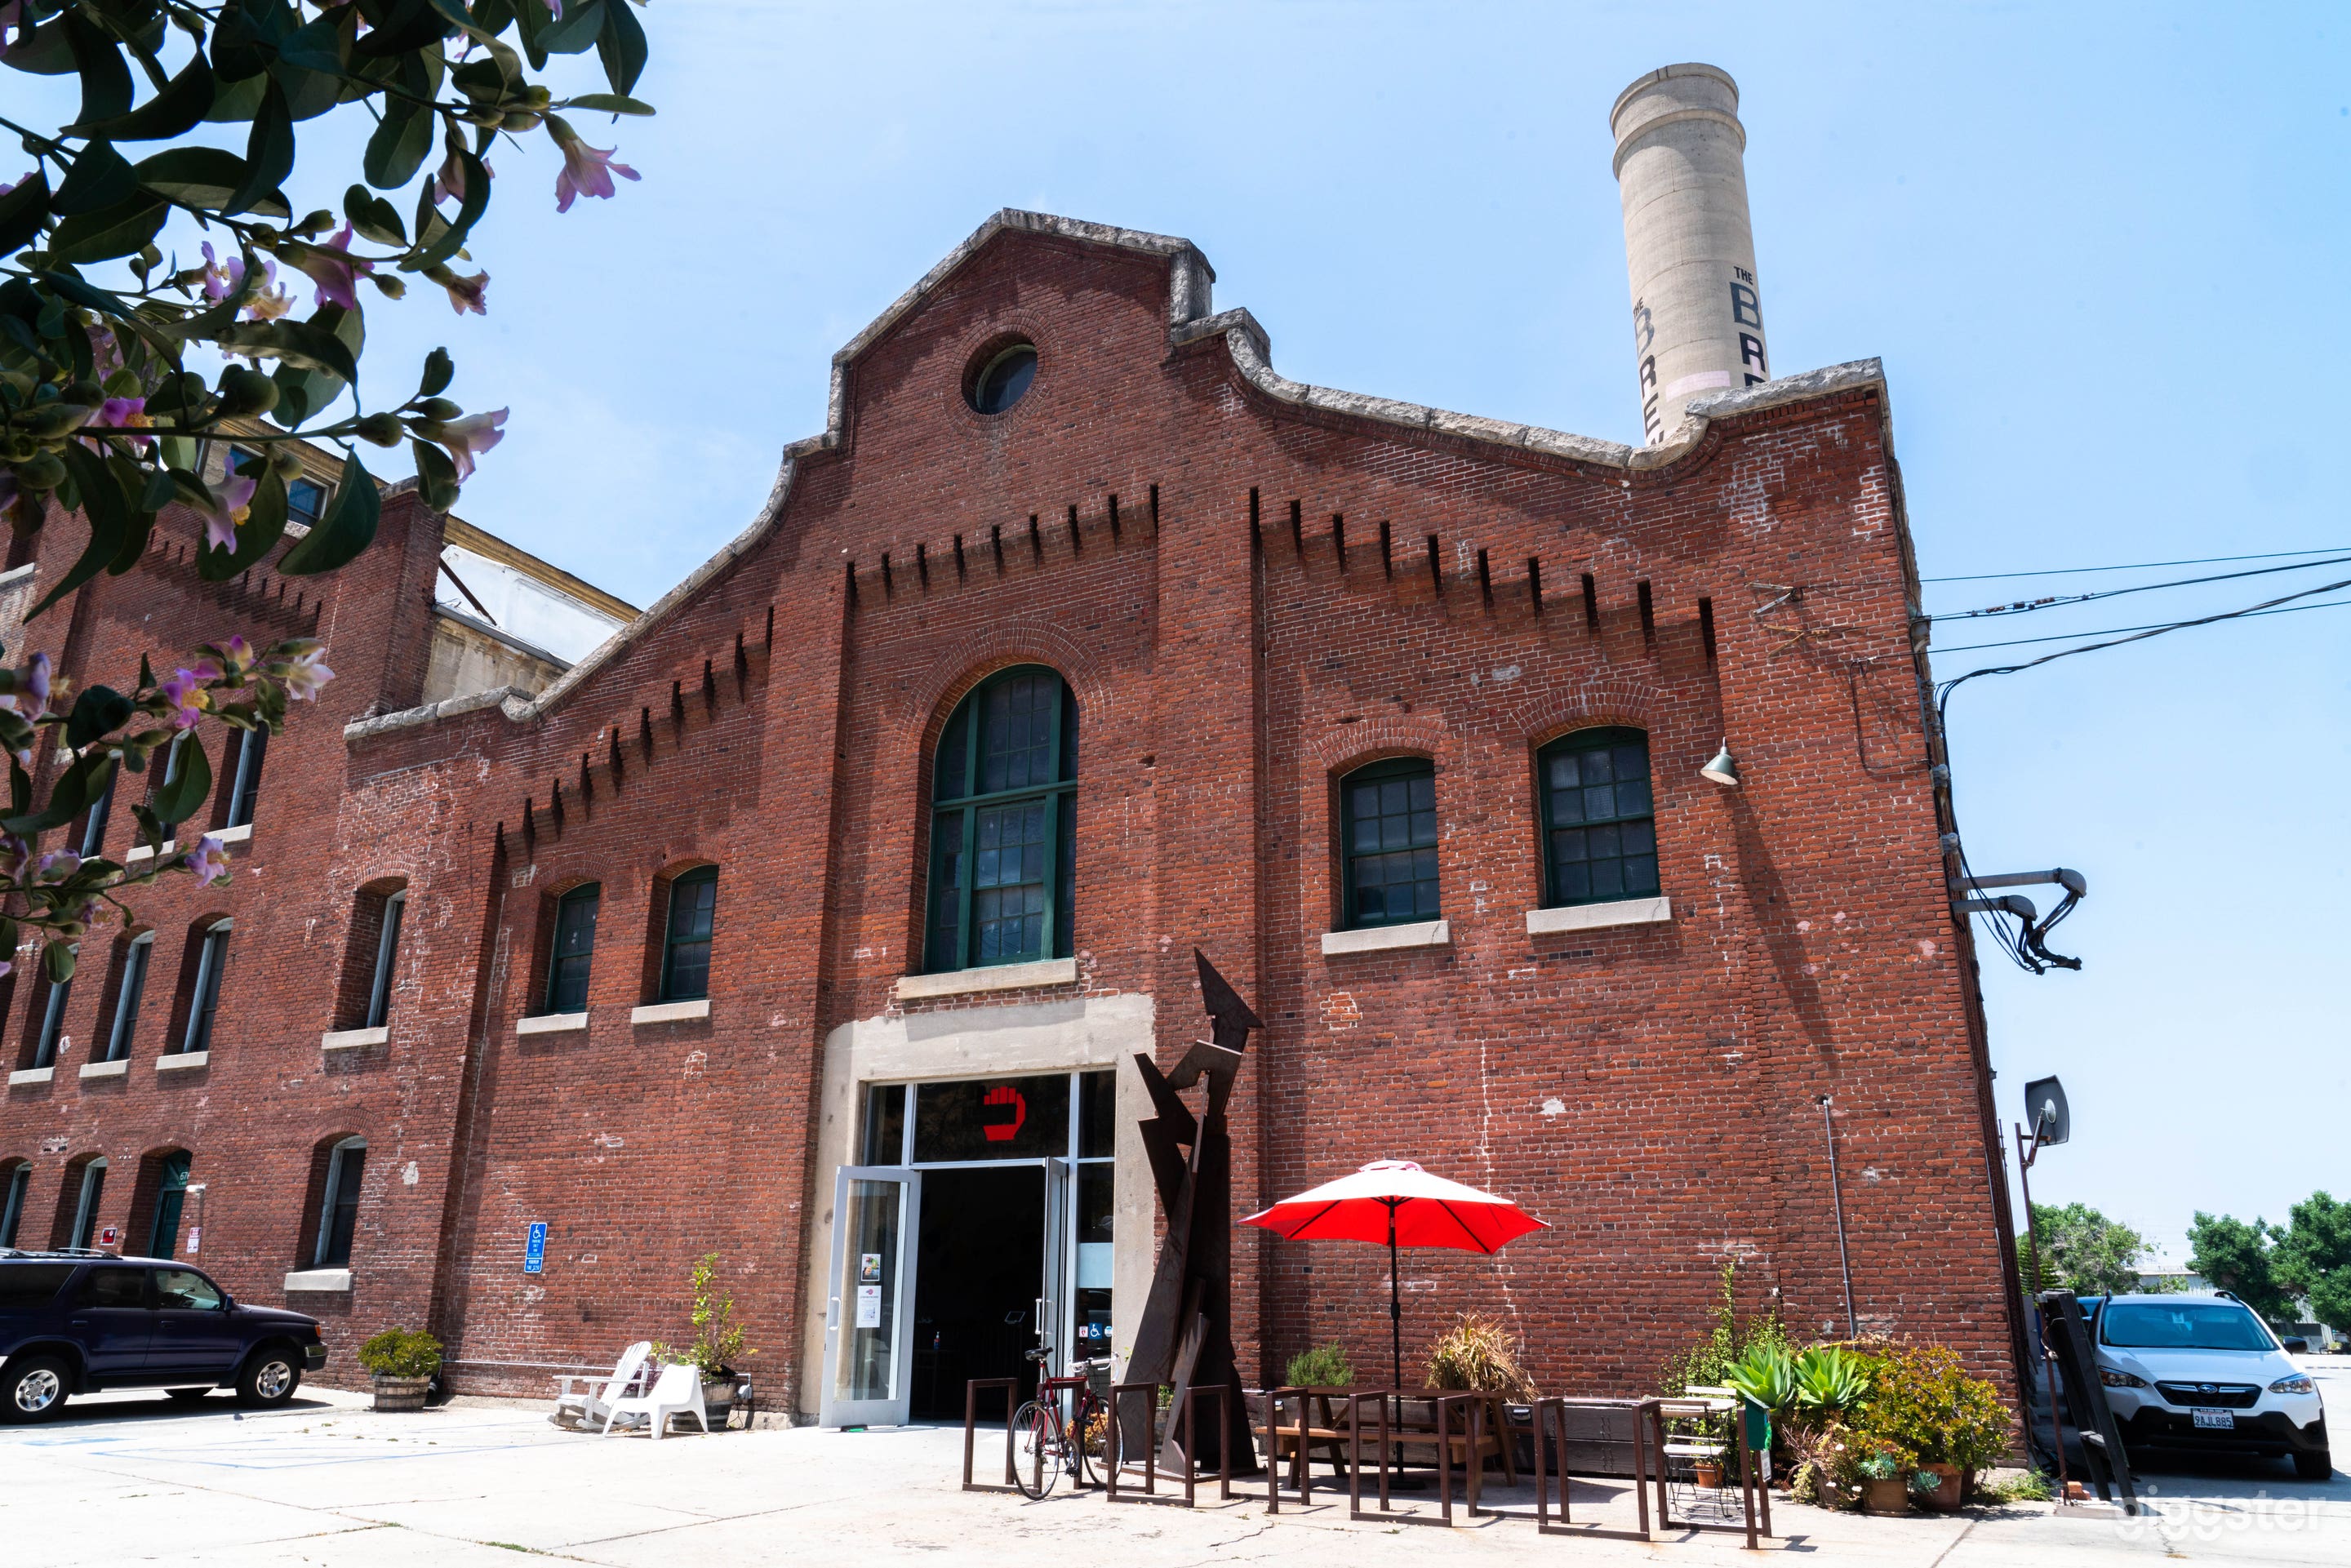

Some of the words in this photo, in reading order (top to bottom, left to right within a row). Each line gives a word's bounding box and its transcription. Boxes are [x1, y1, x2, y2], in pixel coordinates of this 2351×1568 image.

[1734, 266, 1753, 286] THE
[1634, 307, 1664, 446] BRE
[2194, 1415, 2233, 1428] 9AJL885
